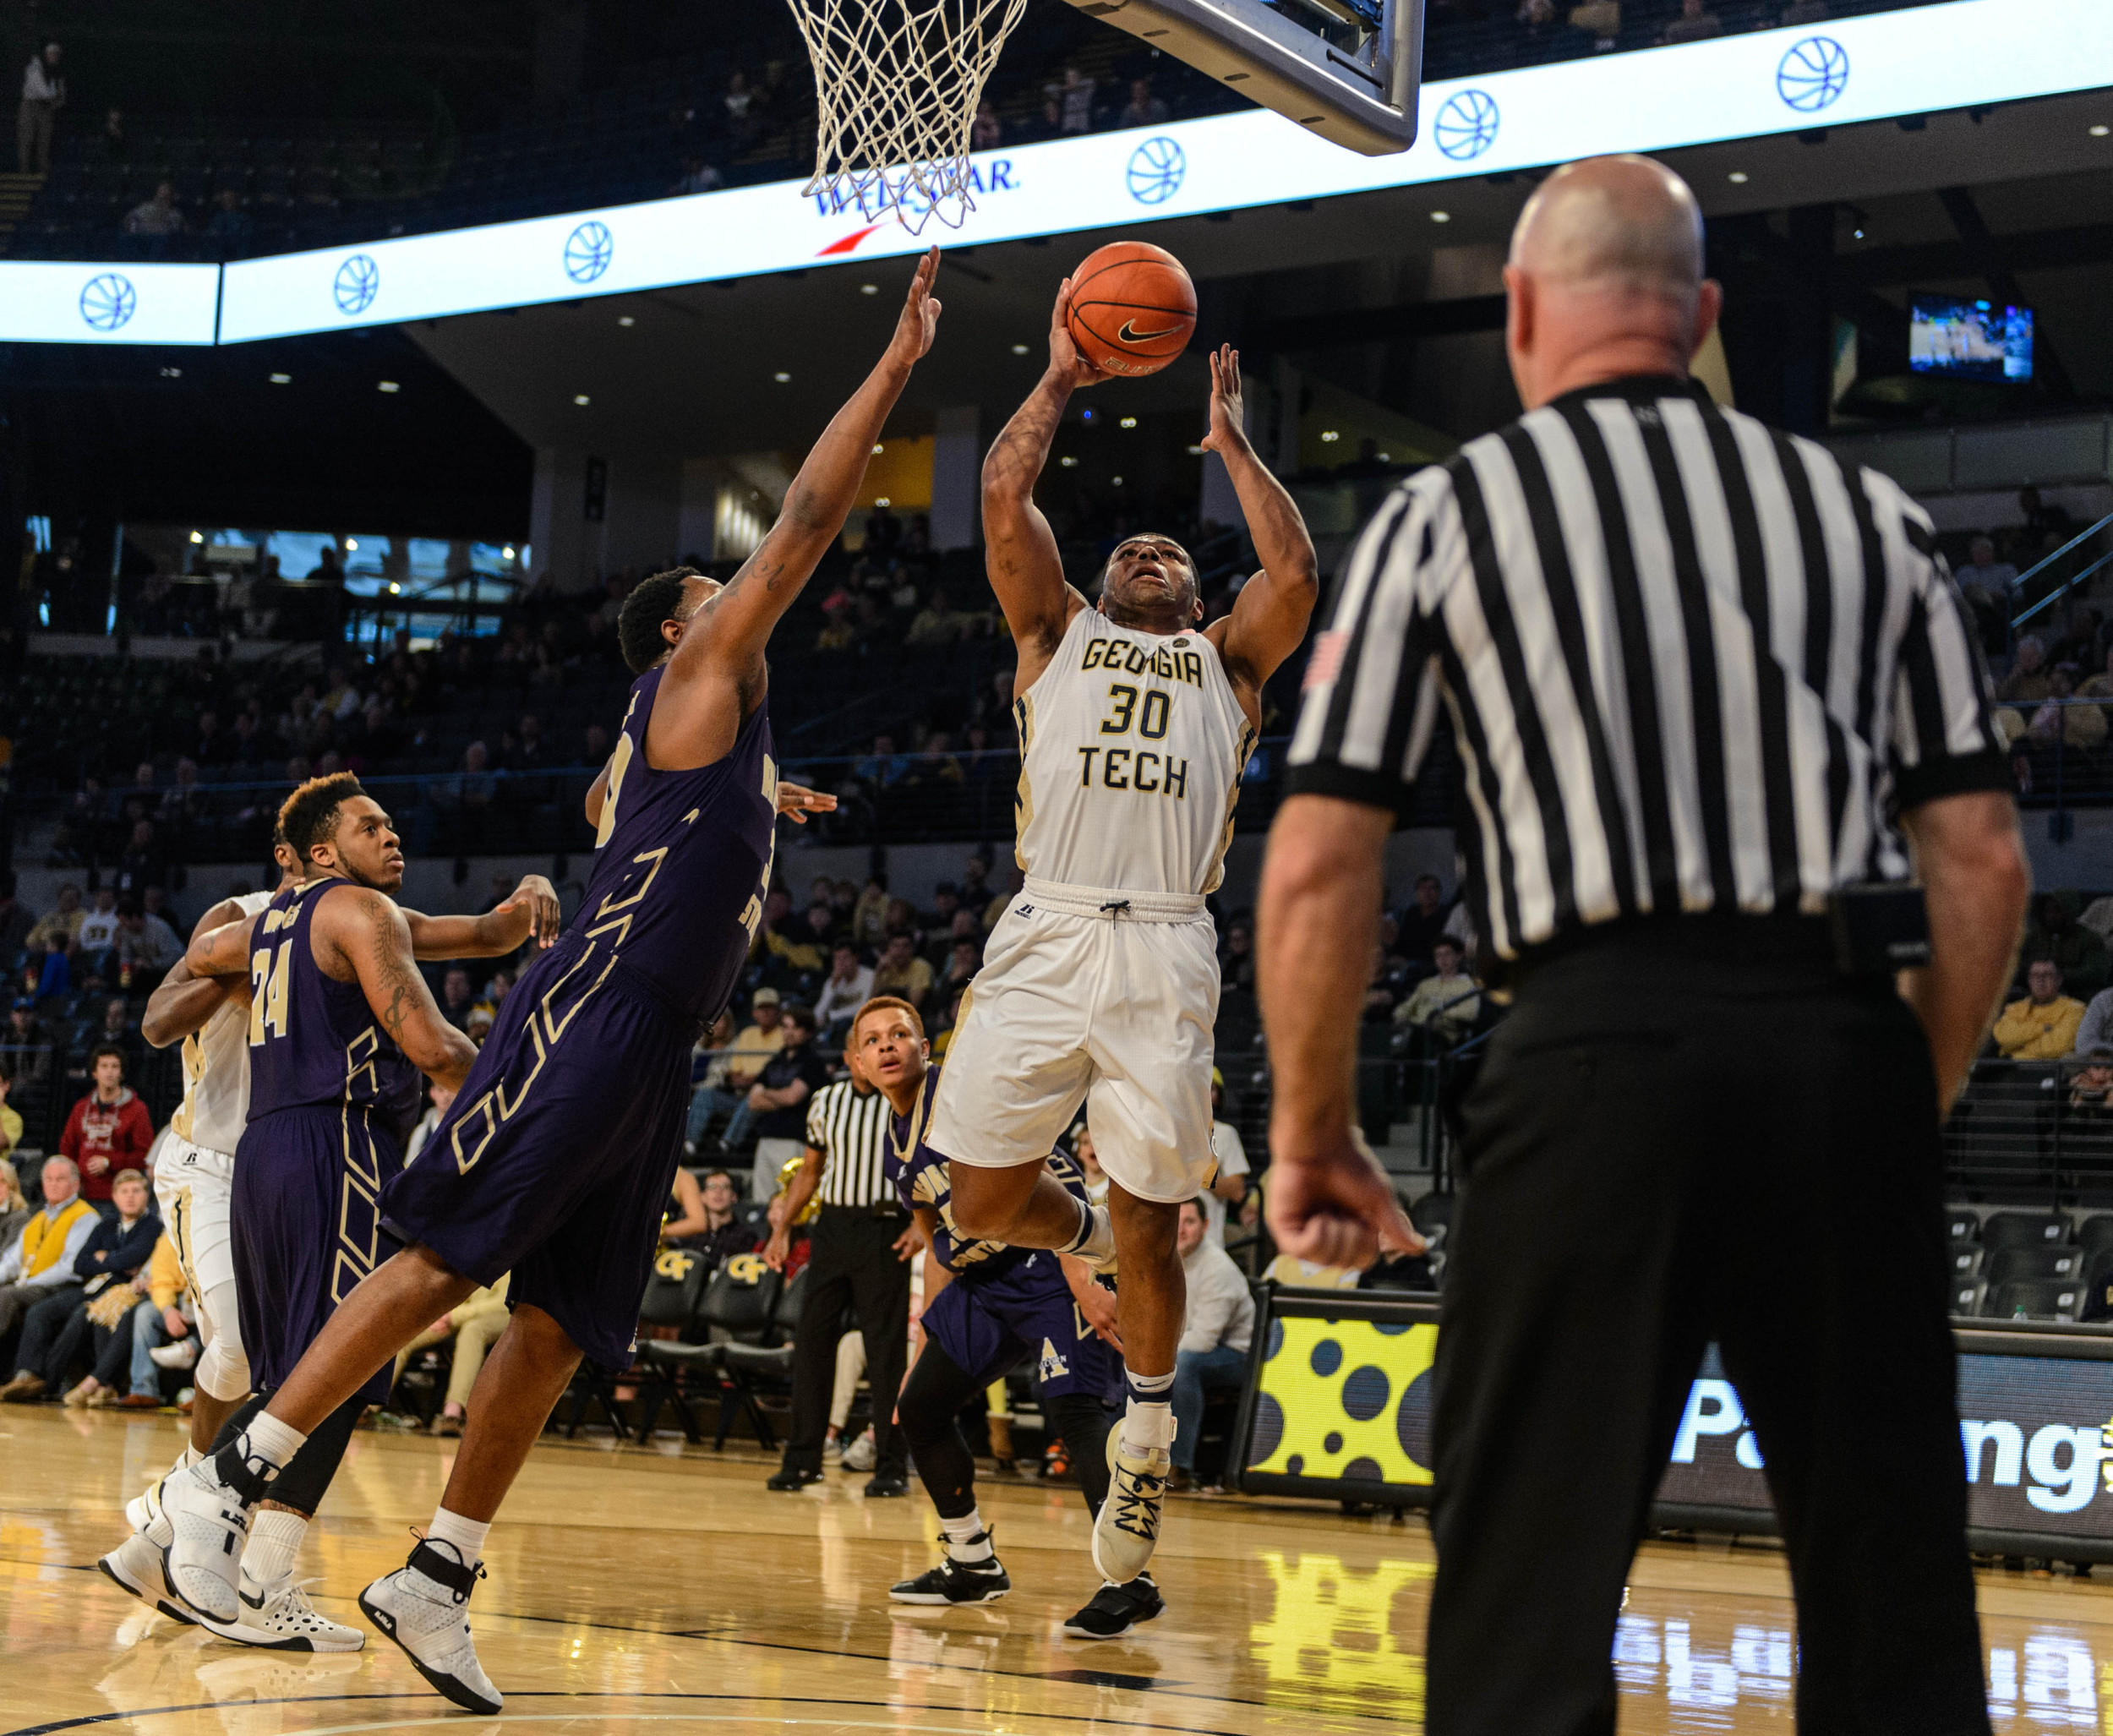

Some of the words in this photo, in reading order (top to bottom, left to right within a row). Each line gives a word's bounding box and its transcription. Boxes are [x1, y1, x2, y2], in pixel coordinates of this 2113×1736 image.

[1100, 683, 1173, 741] 30
[1078, 745, 1189, 801] TECH
[249, 937, 294, 1047] 24
